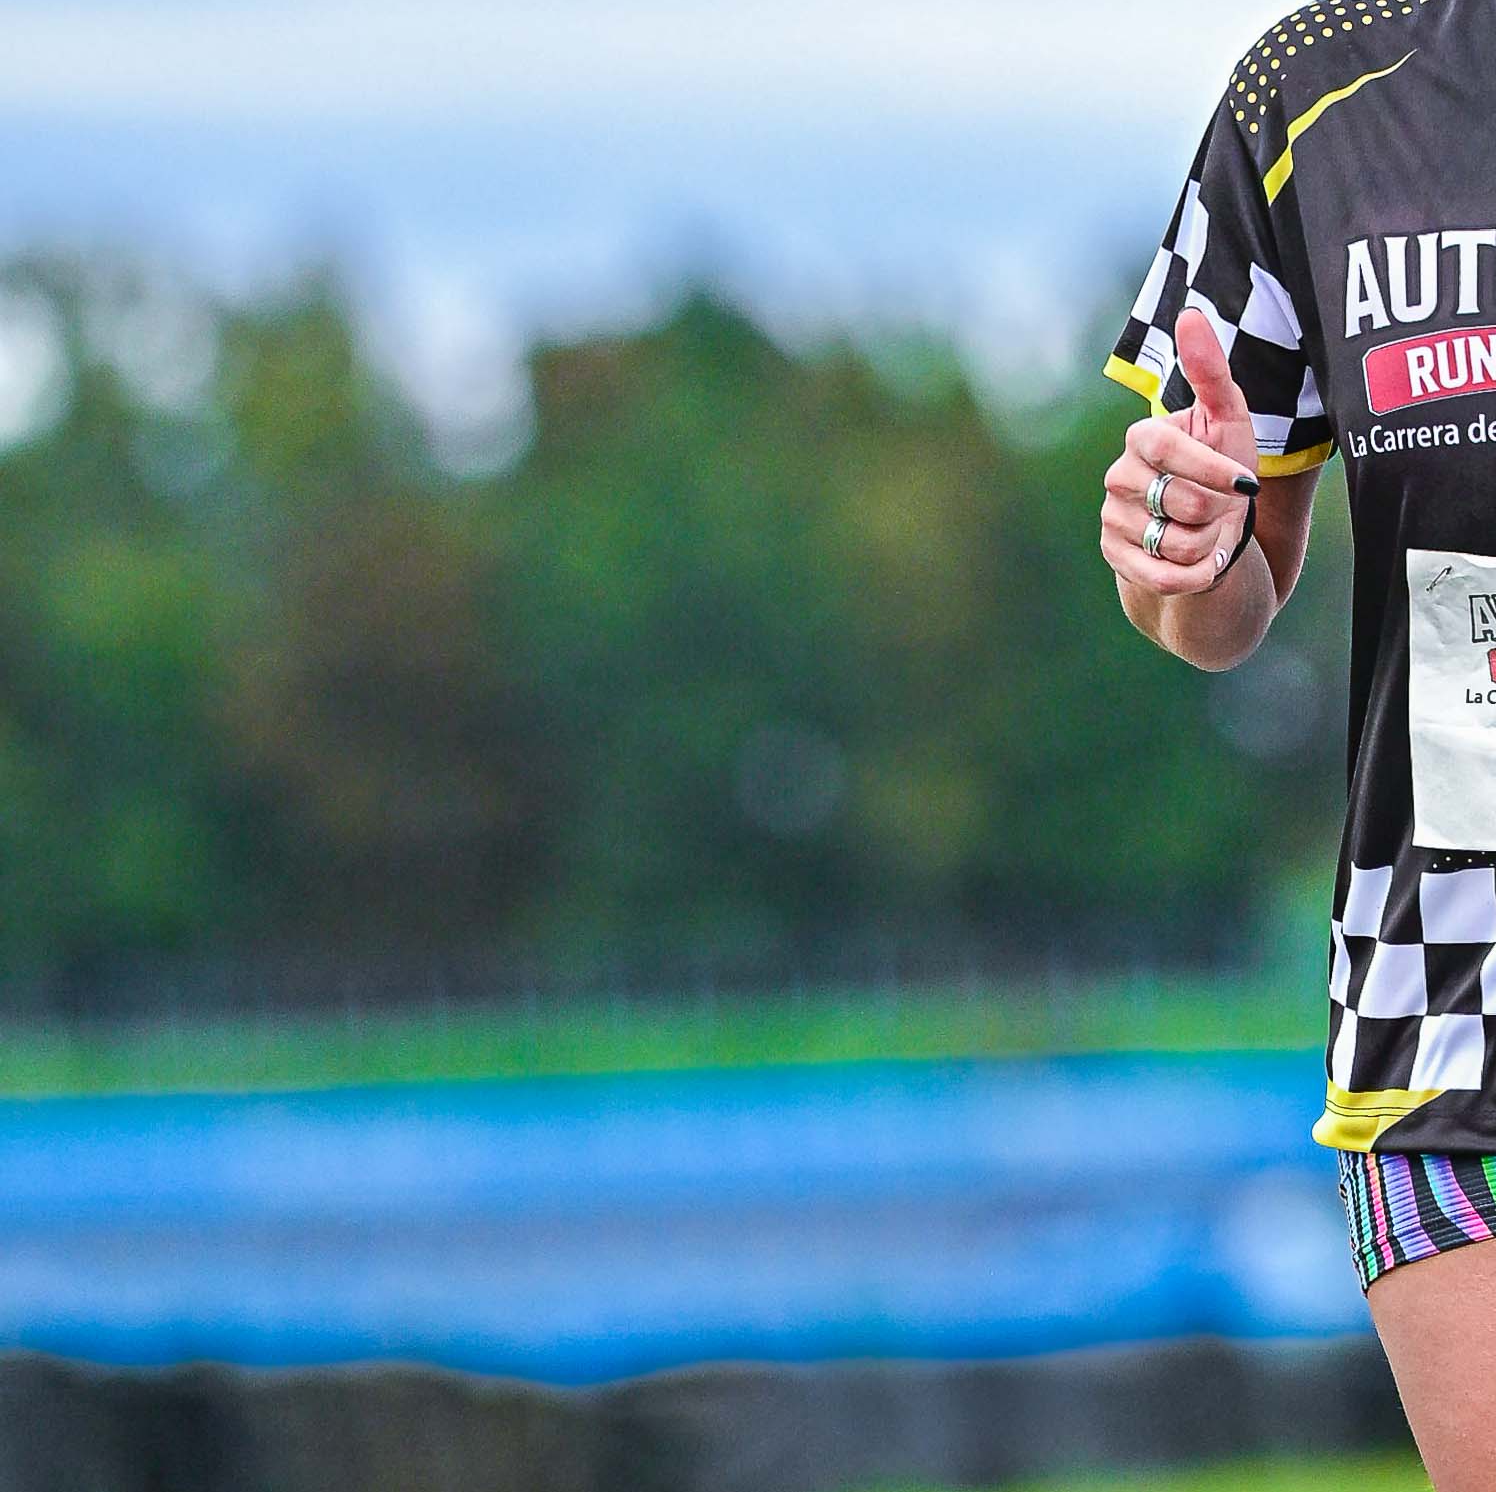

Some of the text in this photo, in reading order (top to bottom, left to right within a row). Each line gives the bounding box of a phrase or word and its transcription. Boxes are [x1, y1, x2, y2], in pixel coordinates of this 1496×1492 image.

[1348, 430, 1368, 458] La
[1370, 423, 1460, 454] Carrera
[1465, 689, 1484, 705] La
